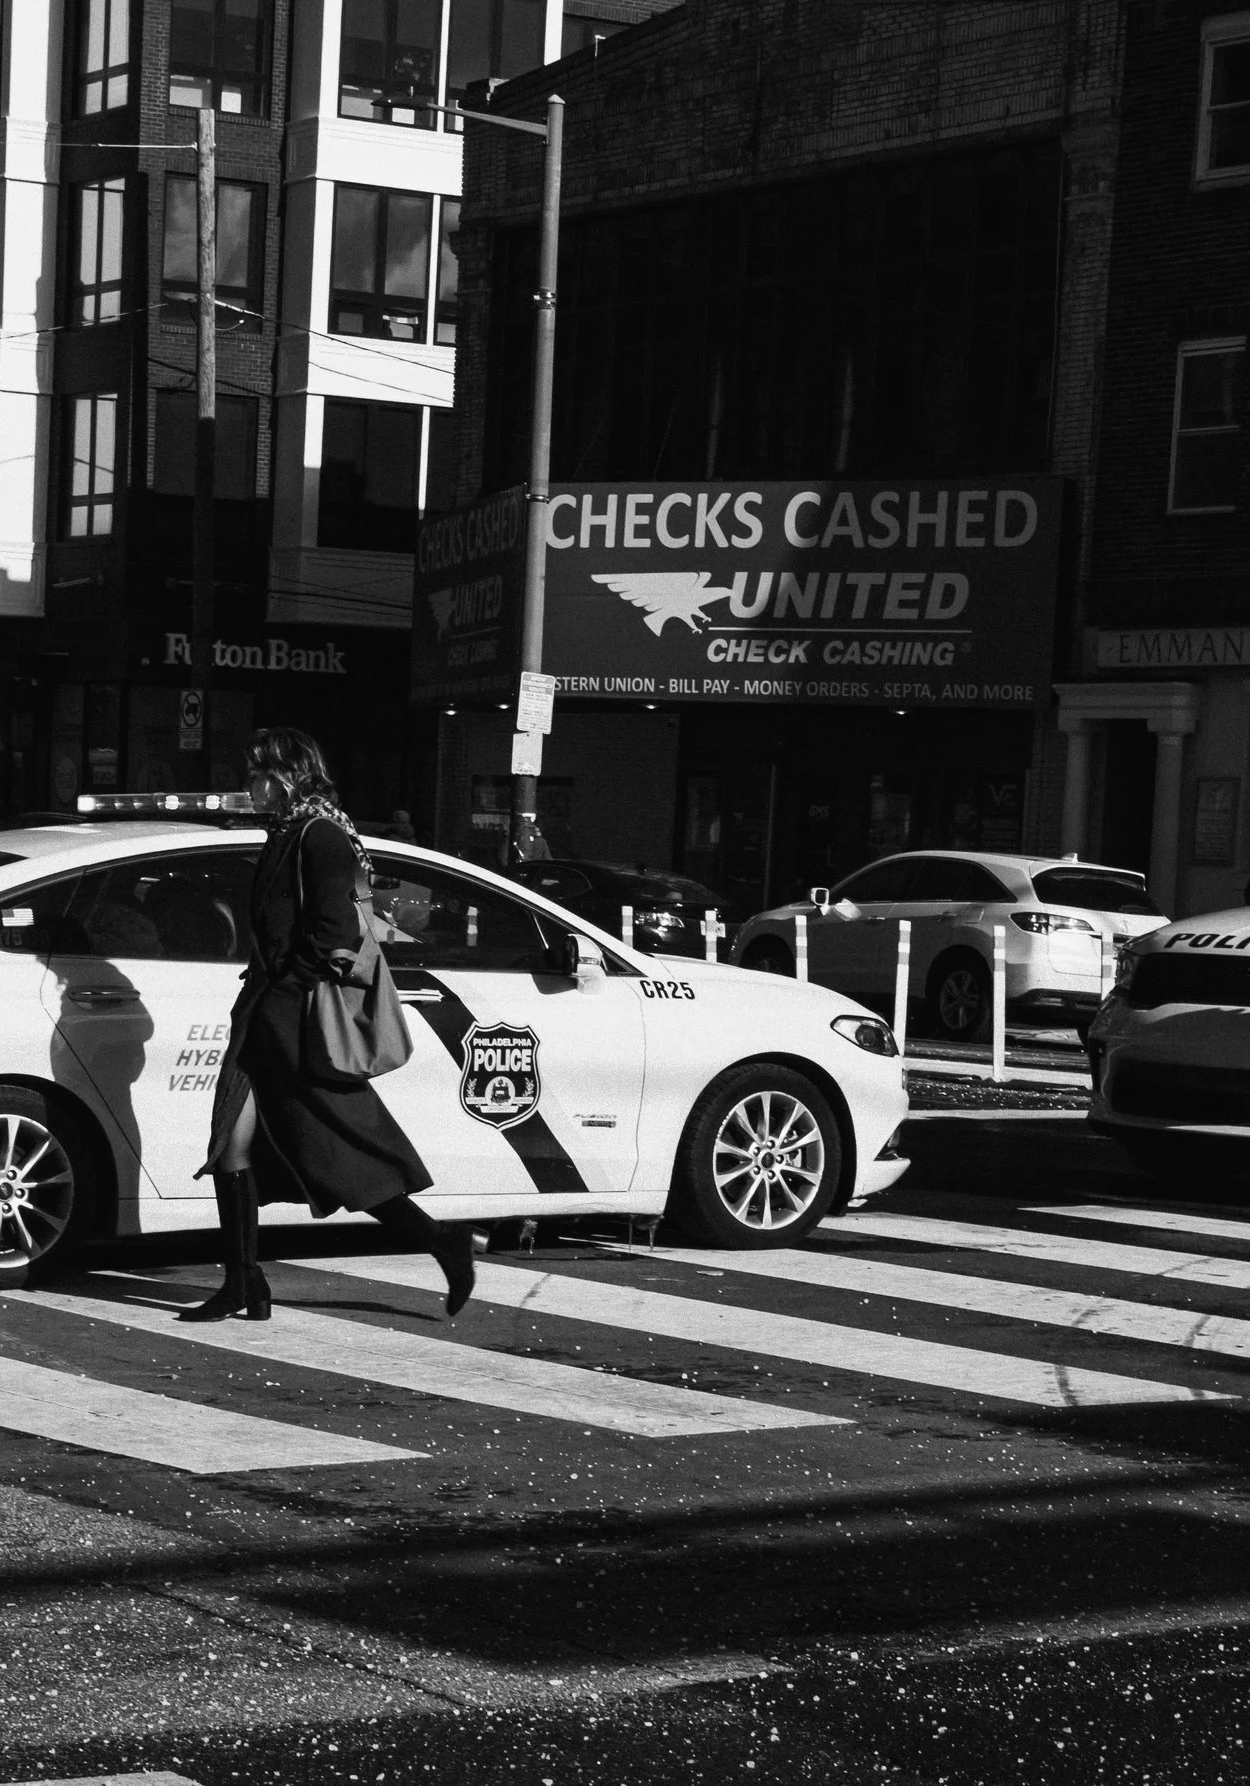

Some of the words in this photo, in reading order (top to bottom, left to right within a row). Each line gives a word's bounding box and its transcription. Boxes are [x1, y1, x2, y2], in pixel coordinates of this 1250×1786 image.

[545, 491, 763, 549] CHECKS
[784, 490, 1038, 549] CASHED
[418, 513, 463, 575] CHECKS
[466, 494, 518, 561] CASHED
[729, 571, 970, 620] UNITED
[163, 632, 264, 669] Fton
[266, 638, 347, 674] Bank
[707, 638, 812, 664] CHECK
[822, 640, 956, 667] CASHING
[1118, 631, 1245, 664] EMMAN
[604, 678, 656, 693] UNION
[669, 678, 699, 694] BILL
[703, 679, 731, 695] PAY
[744, 680, 803, 696] MONEY
[806, 681, 870, 698] ORDERS
[883, 682, 937, 701] SEPTA,
[941, 683, 978, 700] AND
[983, 684, 1034, 701] MORE
[639, 980, 695, 1000] CR25
[473, 1038, 532, 1047] PHILADELPHIA
[473, 1048, 532, 1072] POLICE
[168, 1074, 219, 1091] VEHI
